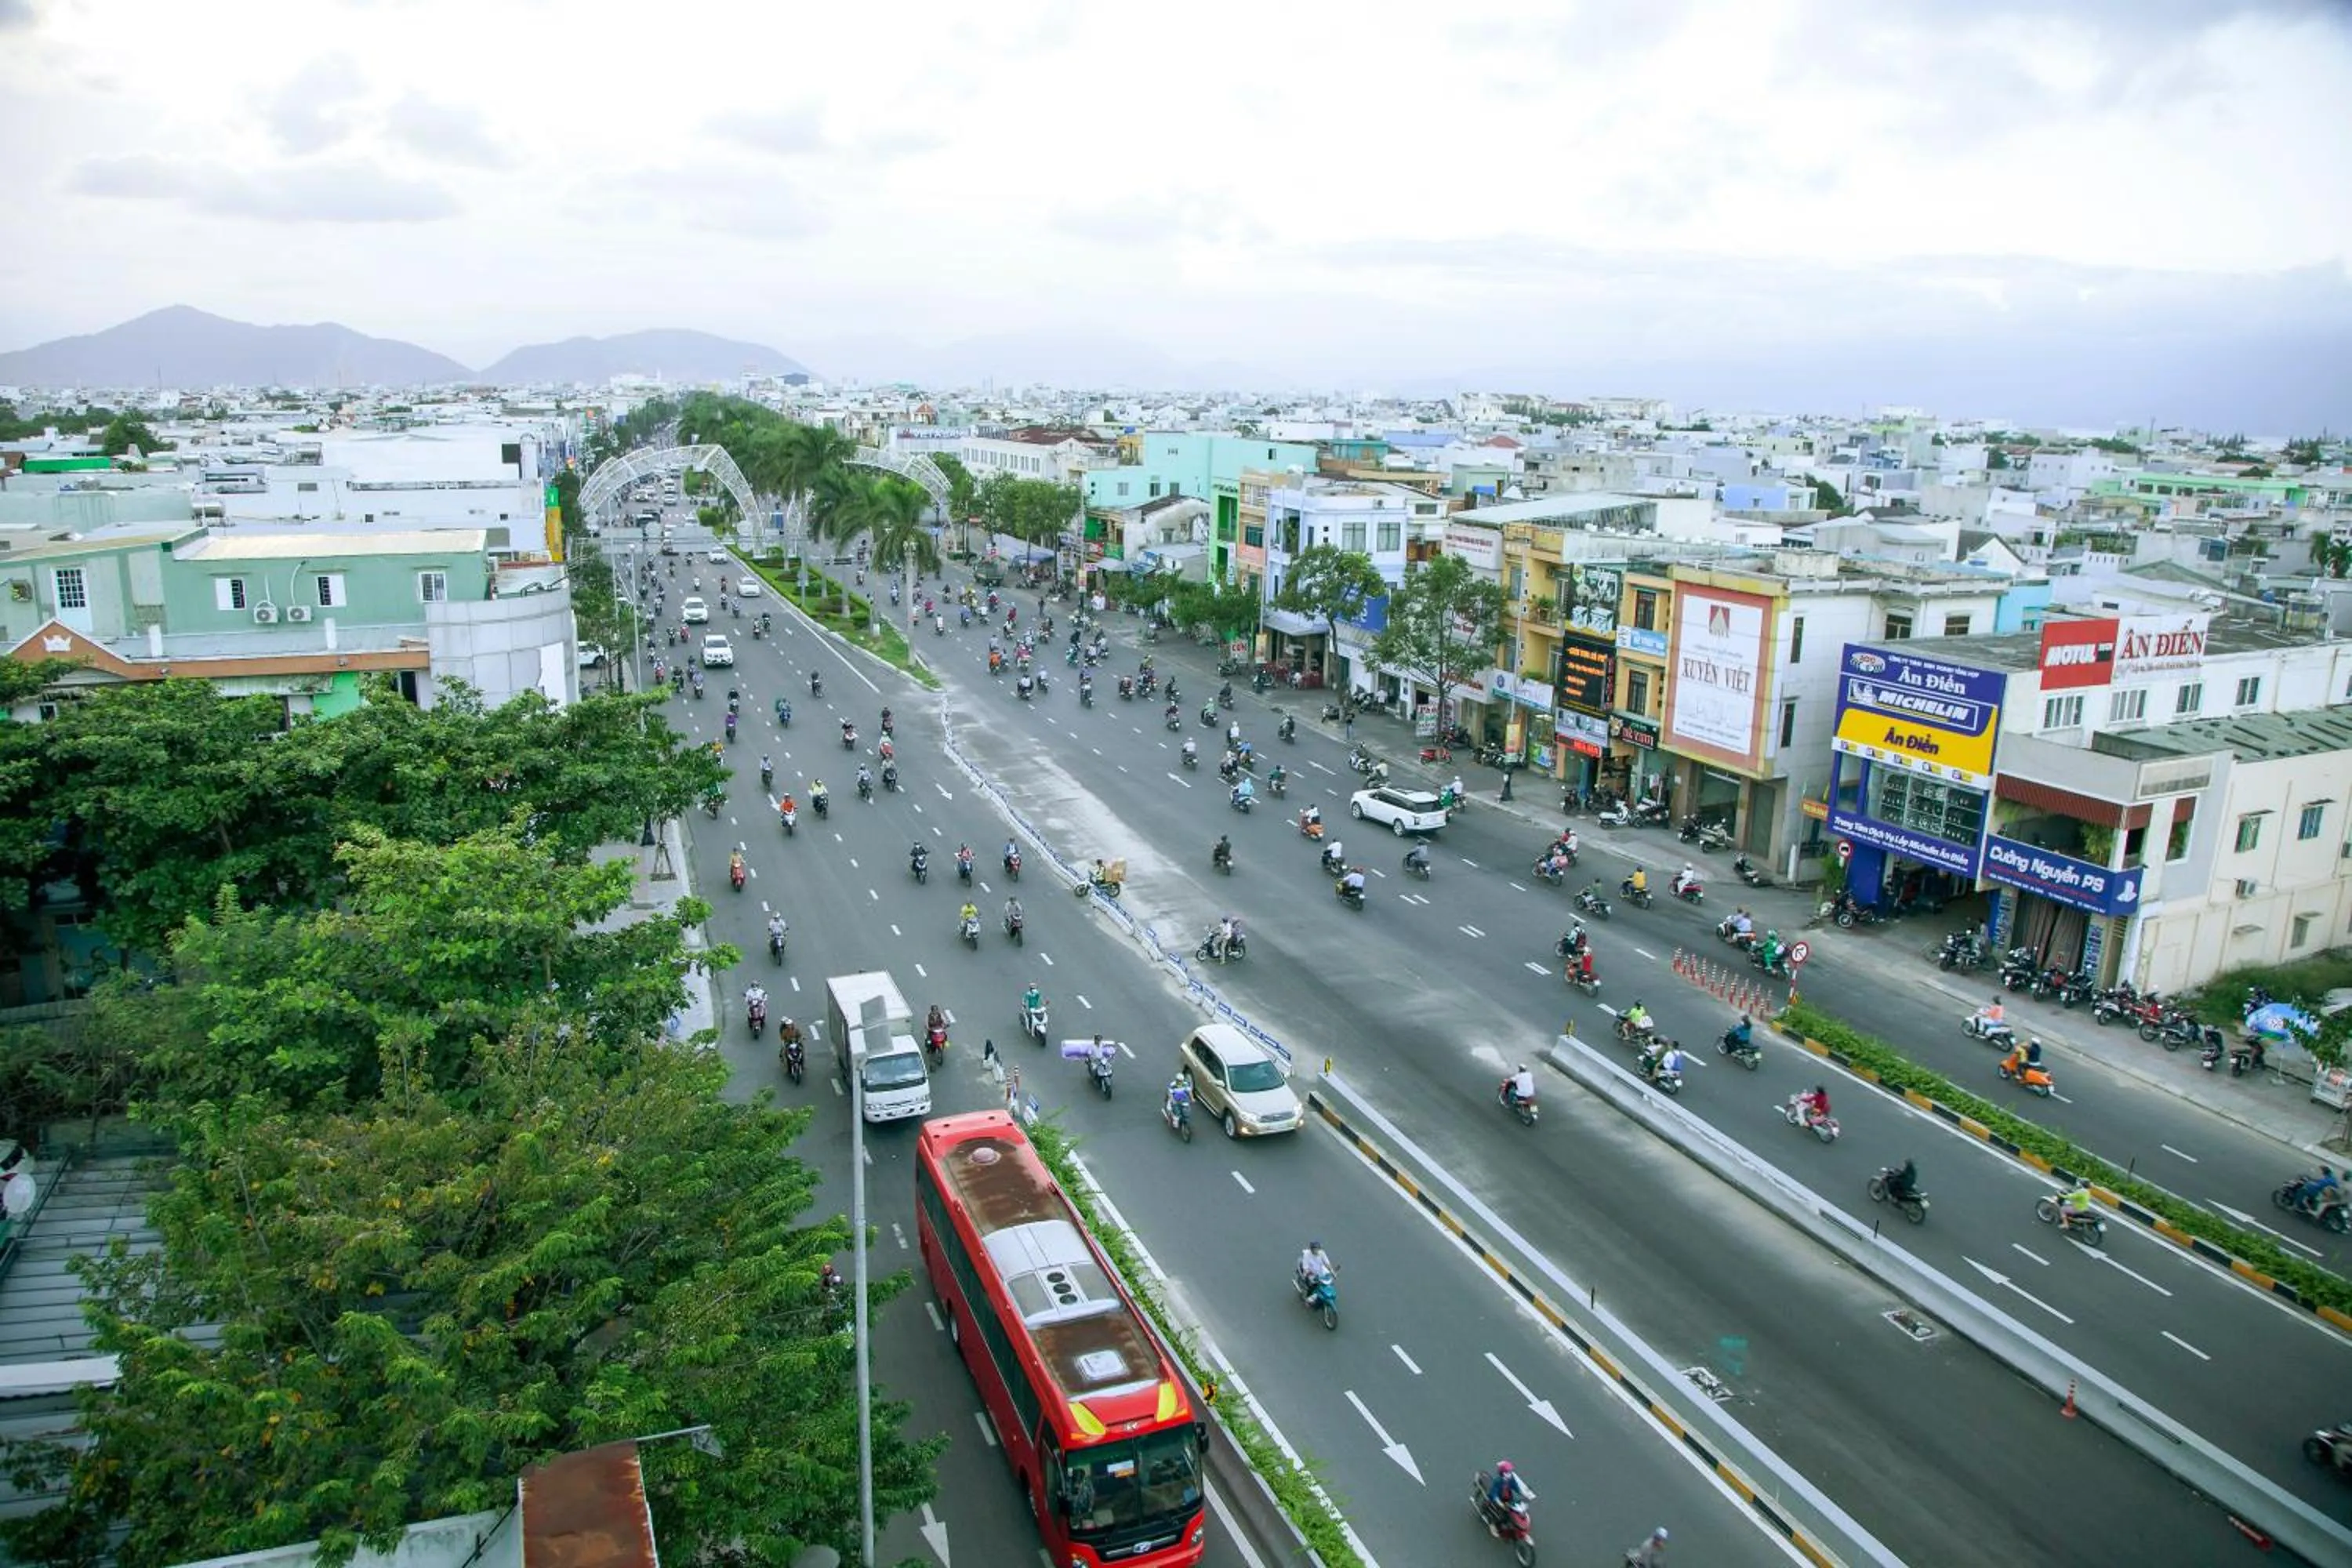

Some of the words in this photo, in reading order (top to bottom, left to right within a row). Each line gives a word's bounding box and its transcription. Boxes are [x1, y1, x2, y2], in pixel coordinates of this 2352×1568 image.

[2045, 644, 2096, 666] MOTUL
[2122, 629, 2152, 659] ÂN
[1898, 666, 1922, 686] Ân
[1925, 673, 1966, 695] Điển
[1878, 689, 1970, 720] MICHELIN
[1883, 727, 1904, 746] Ân
[1835, 816, 1853, 830] Trung
[1907, 840, 1940, 856] Michelin
[2082, 874, 2105, 893] PS
